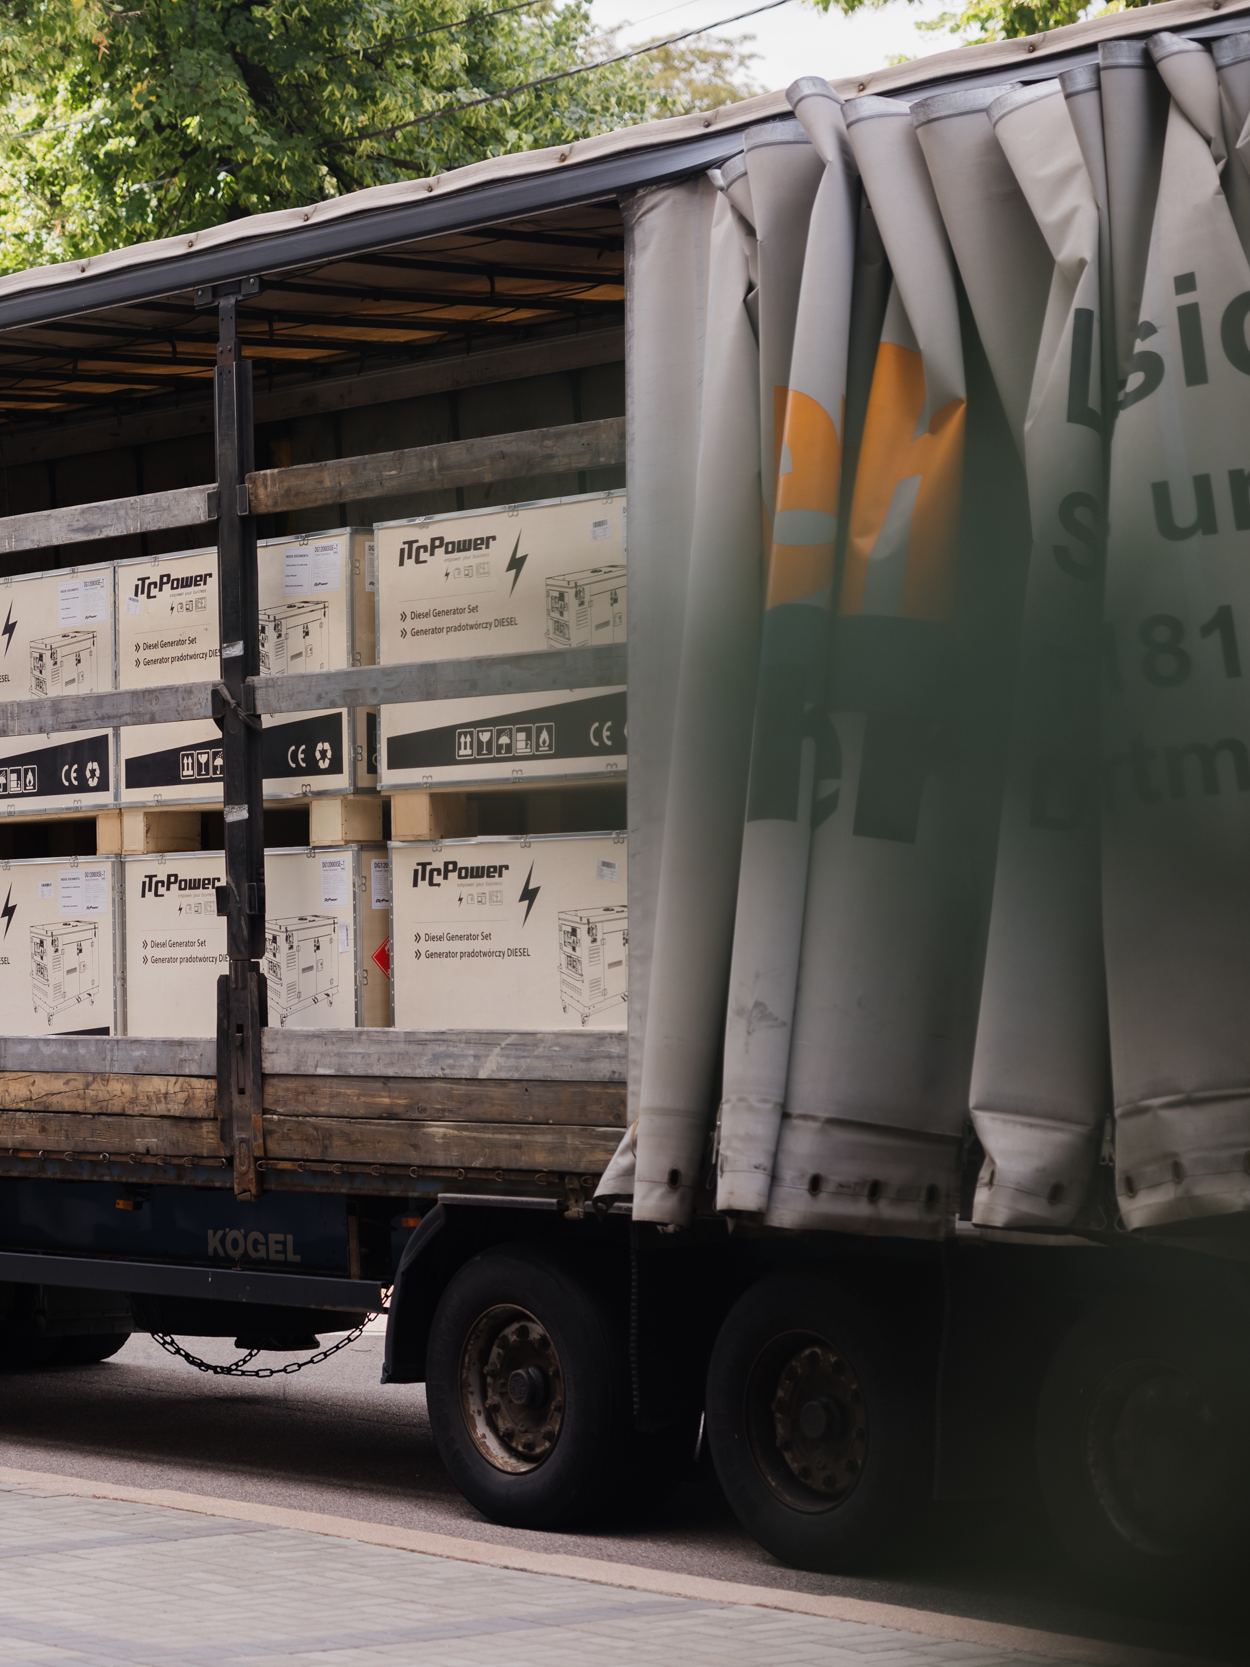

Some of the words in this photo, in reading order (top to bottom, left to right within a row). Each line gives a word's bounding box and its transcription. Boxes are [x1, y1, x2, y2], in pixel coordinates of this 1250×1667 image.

[410, 608, 431, 621] Diesel
[432, 605, 466, 619] Generator
[468, 604, 479, 615] Set
[410, 624, 444, 637] Generator
[446, 620, 492, 635] pradotwórczy
[494, 616, 518, 628] DIESEL
[142, 641, 159, 652] Diesel
[160, 638, 186, 650] Generator
[188, 636, 197, 646] Set
[142, 655, 170, 668] Generator
[170, 650, 208, 666] pradotwórczy
[150, 940, 168, 950] Diesel
[168, 939, 196, 949] Generator
[196, 938, 206, 948] Set
[424, 932, 445, 942] Diesel
[446, 932, 480, 942] Generator
[480, 932, 492, 941] Set
[150, 955, 178, 965] Generator
[179, 954, 218, 966] pradotwórczy
[218, 954, 229, 963] DIE
[424, 949, 458, 959] Generator
[460, 948, 506, 960] pradotwórczy
[506, 948, 531, 958] DIESEL
[207, 1228, 301, 1262] KÖGEL
